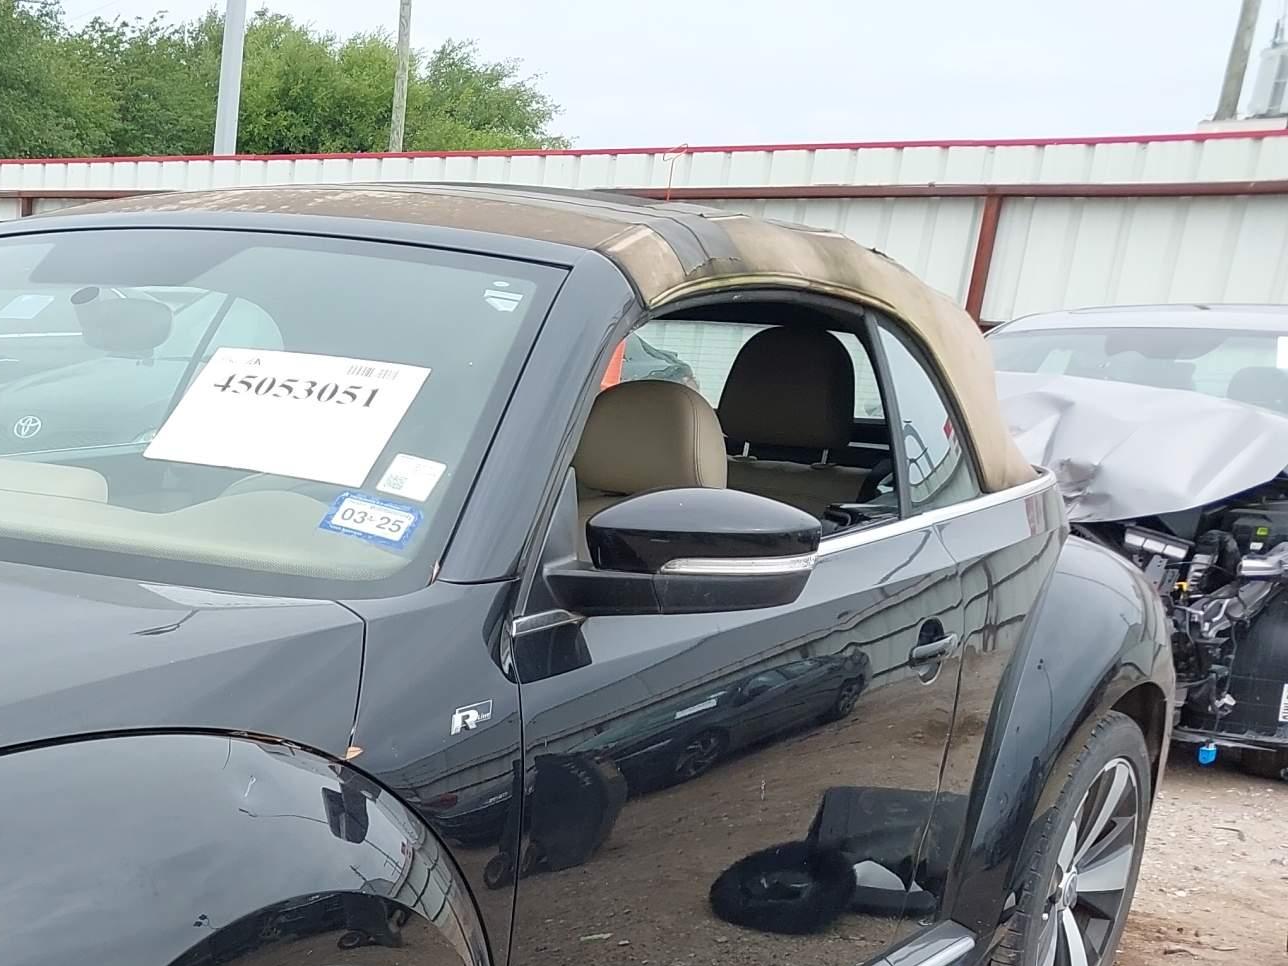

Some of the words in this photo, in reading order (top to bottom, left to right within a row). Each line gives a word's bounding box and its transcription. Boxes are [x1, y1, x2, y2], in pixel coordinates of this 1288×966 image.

[213, 373, 380, 408] 45053051
[341, 508, 368, 524] 03
[376, 516, 404, 533] 25
